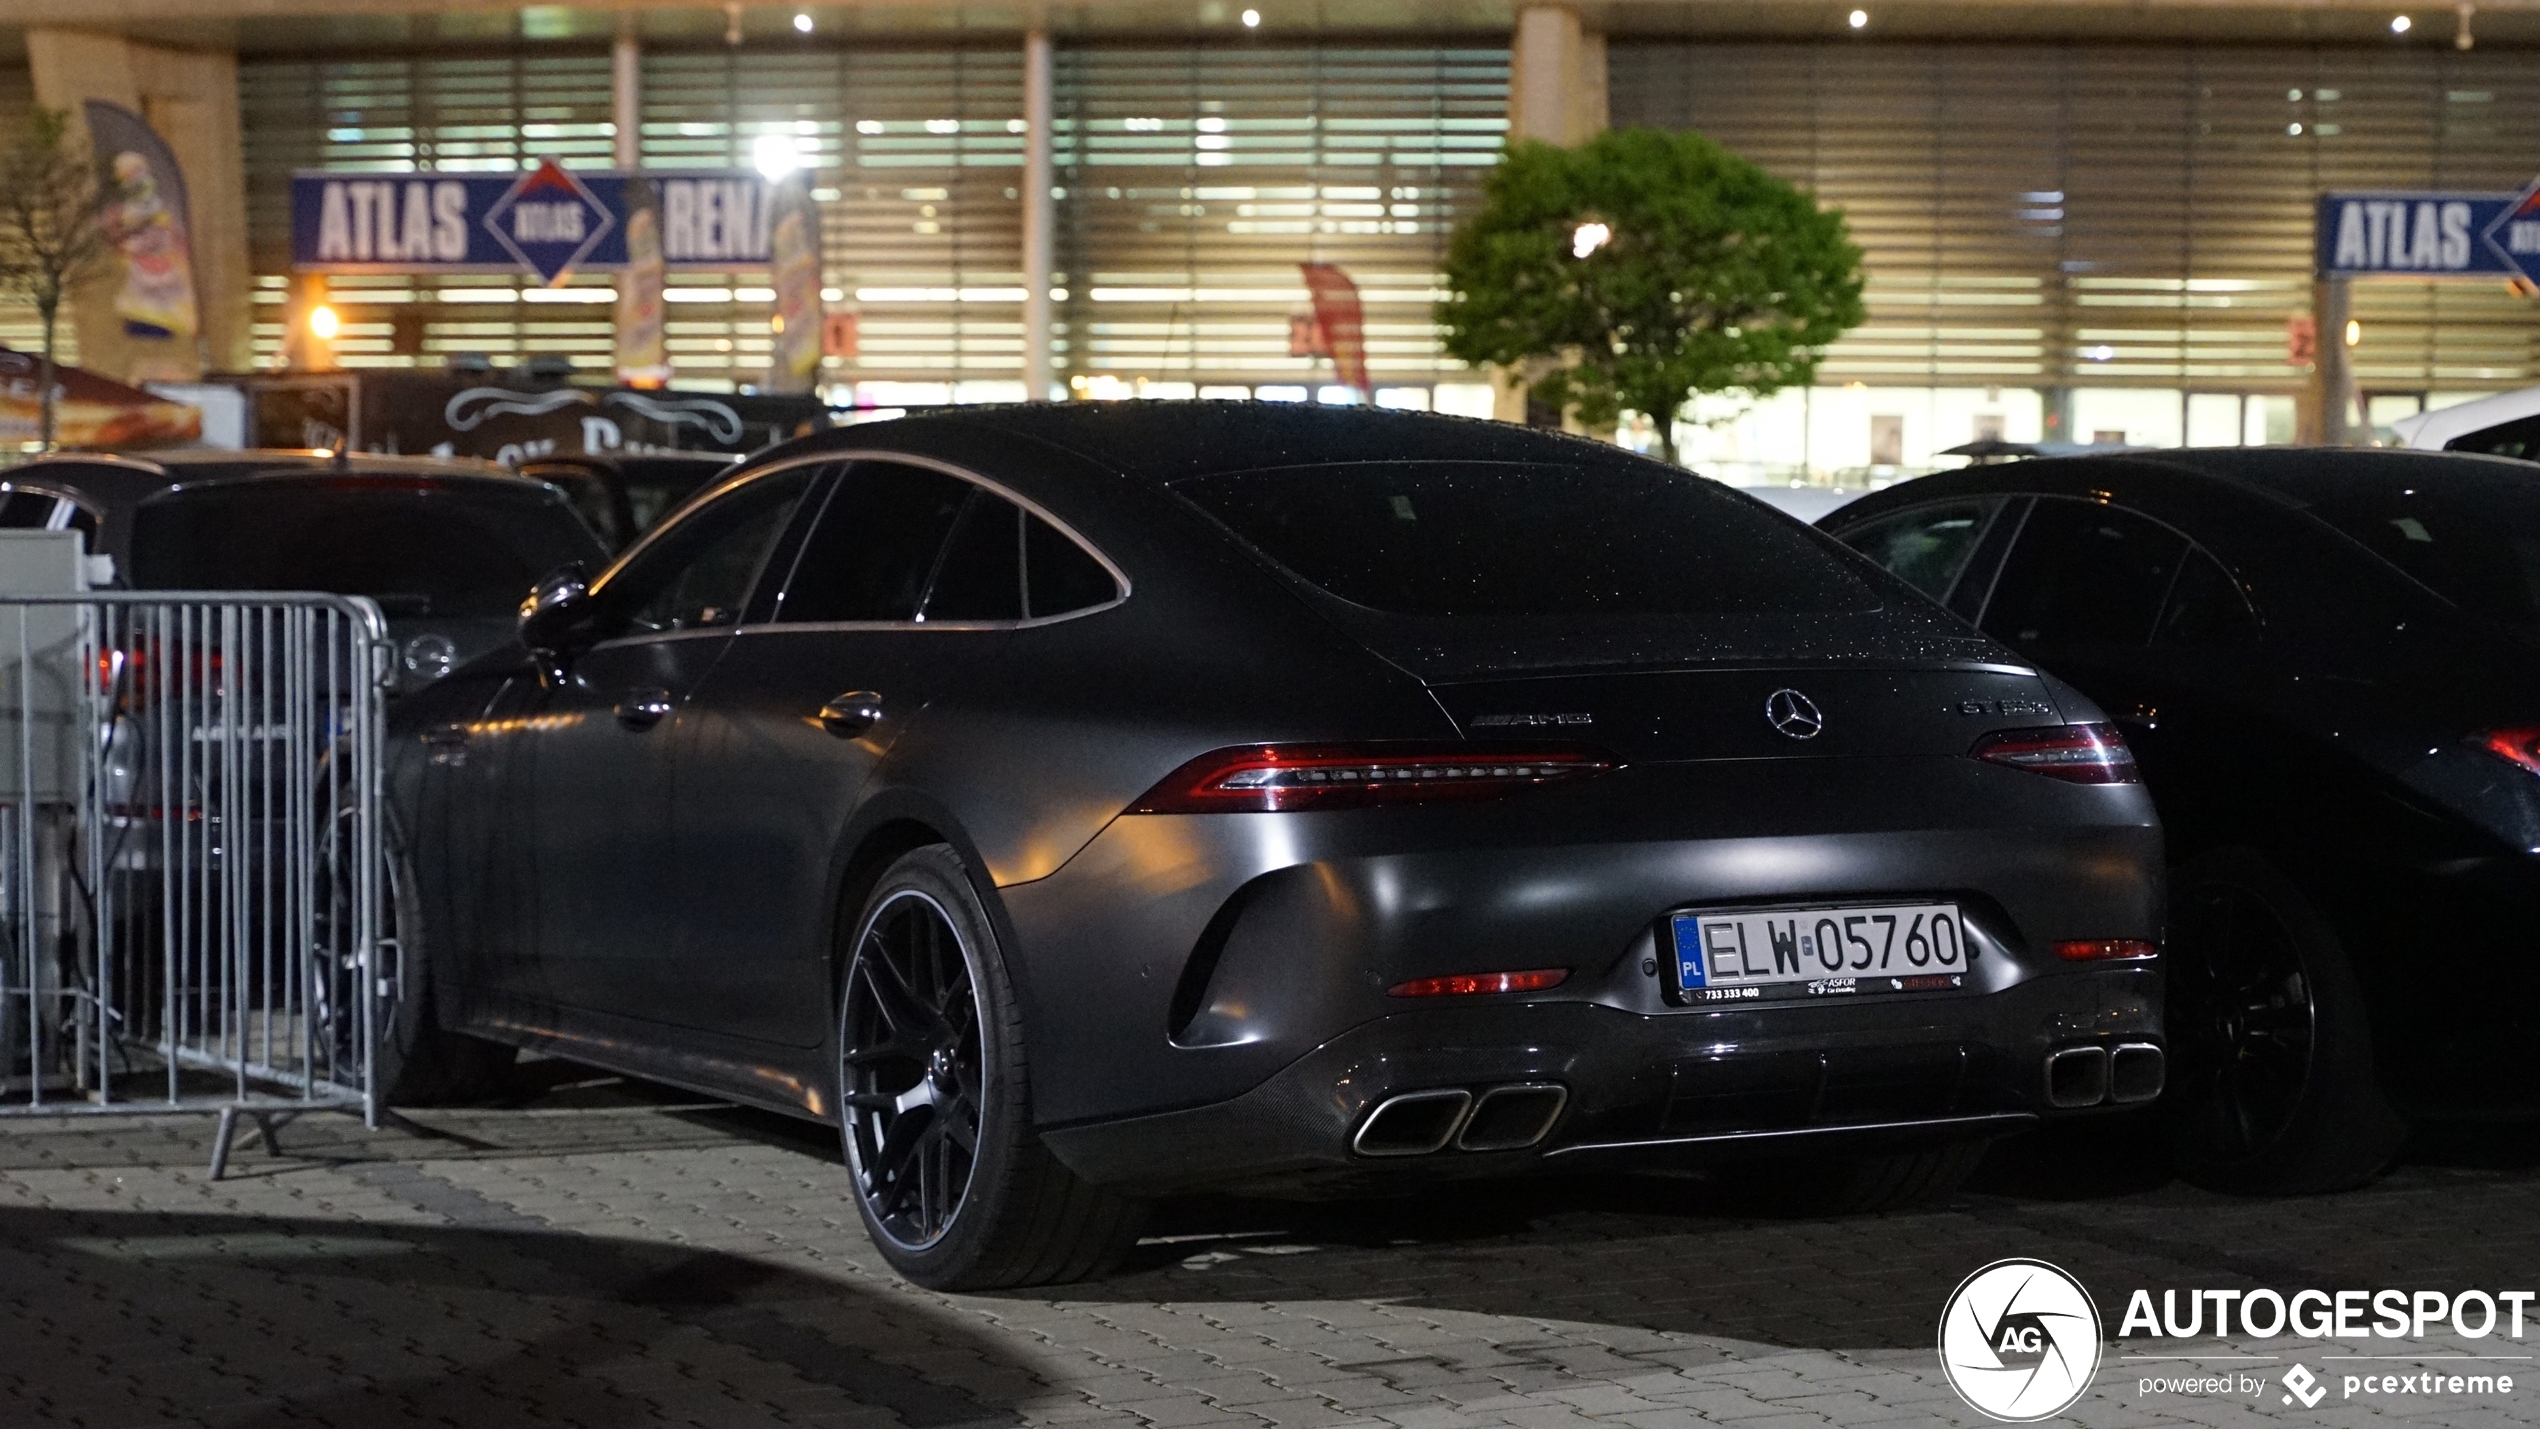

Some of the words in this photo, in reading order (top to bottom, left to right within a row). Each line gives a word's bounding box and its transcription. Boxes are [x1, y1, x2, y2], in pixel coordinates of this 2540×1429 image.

[319, 180, 469, 261] ATLAS
[514, 201, 586, 243] ATLAS
[2335, 201, 2472, 269] ATLAS
[1703, 919, 1800, 980] ELW
[1814, 912, 1958, 972] 05760
[1682, 961, 1701, 977] PL
[1828, 978, 1856, 987] ASFOR
[1705, 989, 1722, 999] 733
[1724, 988, 1740, 998] 333
[1742, 987, 1759, 997] 400
